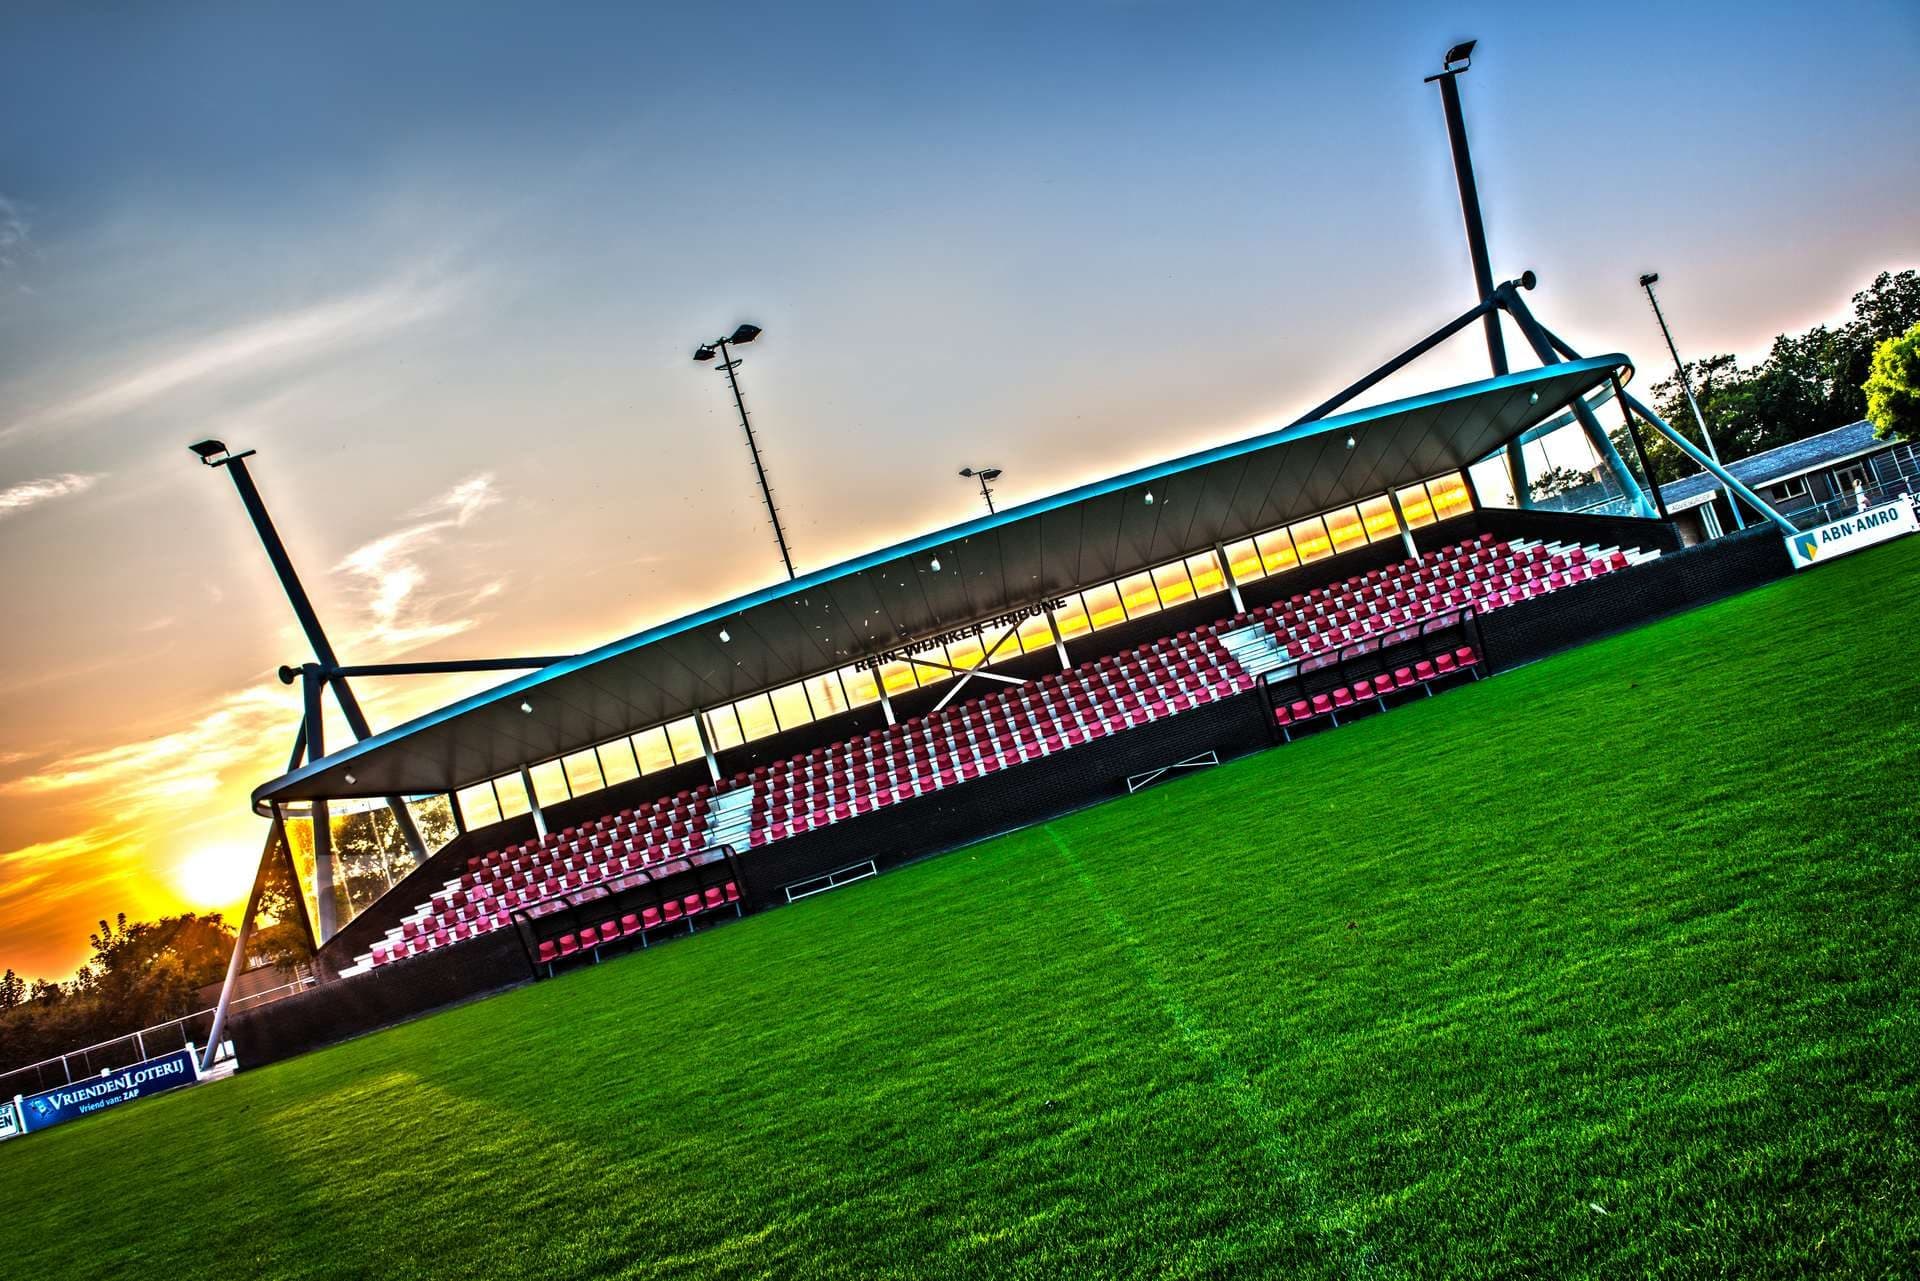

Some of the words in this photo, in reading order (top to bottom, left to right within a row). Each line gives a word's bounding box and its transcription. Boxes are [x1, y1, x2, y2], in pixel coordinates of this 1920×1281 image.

[855, 650, 897, 673] REIN
[993, 599, 1067, 629] TRIBUNE
[79, 1099, 105, 1113] Vriend
[105, 1095, 122, 1106] van:
[122, 1088, 140, 1101] ZAP
